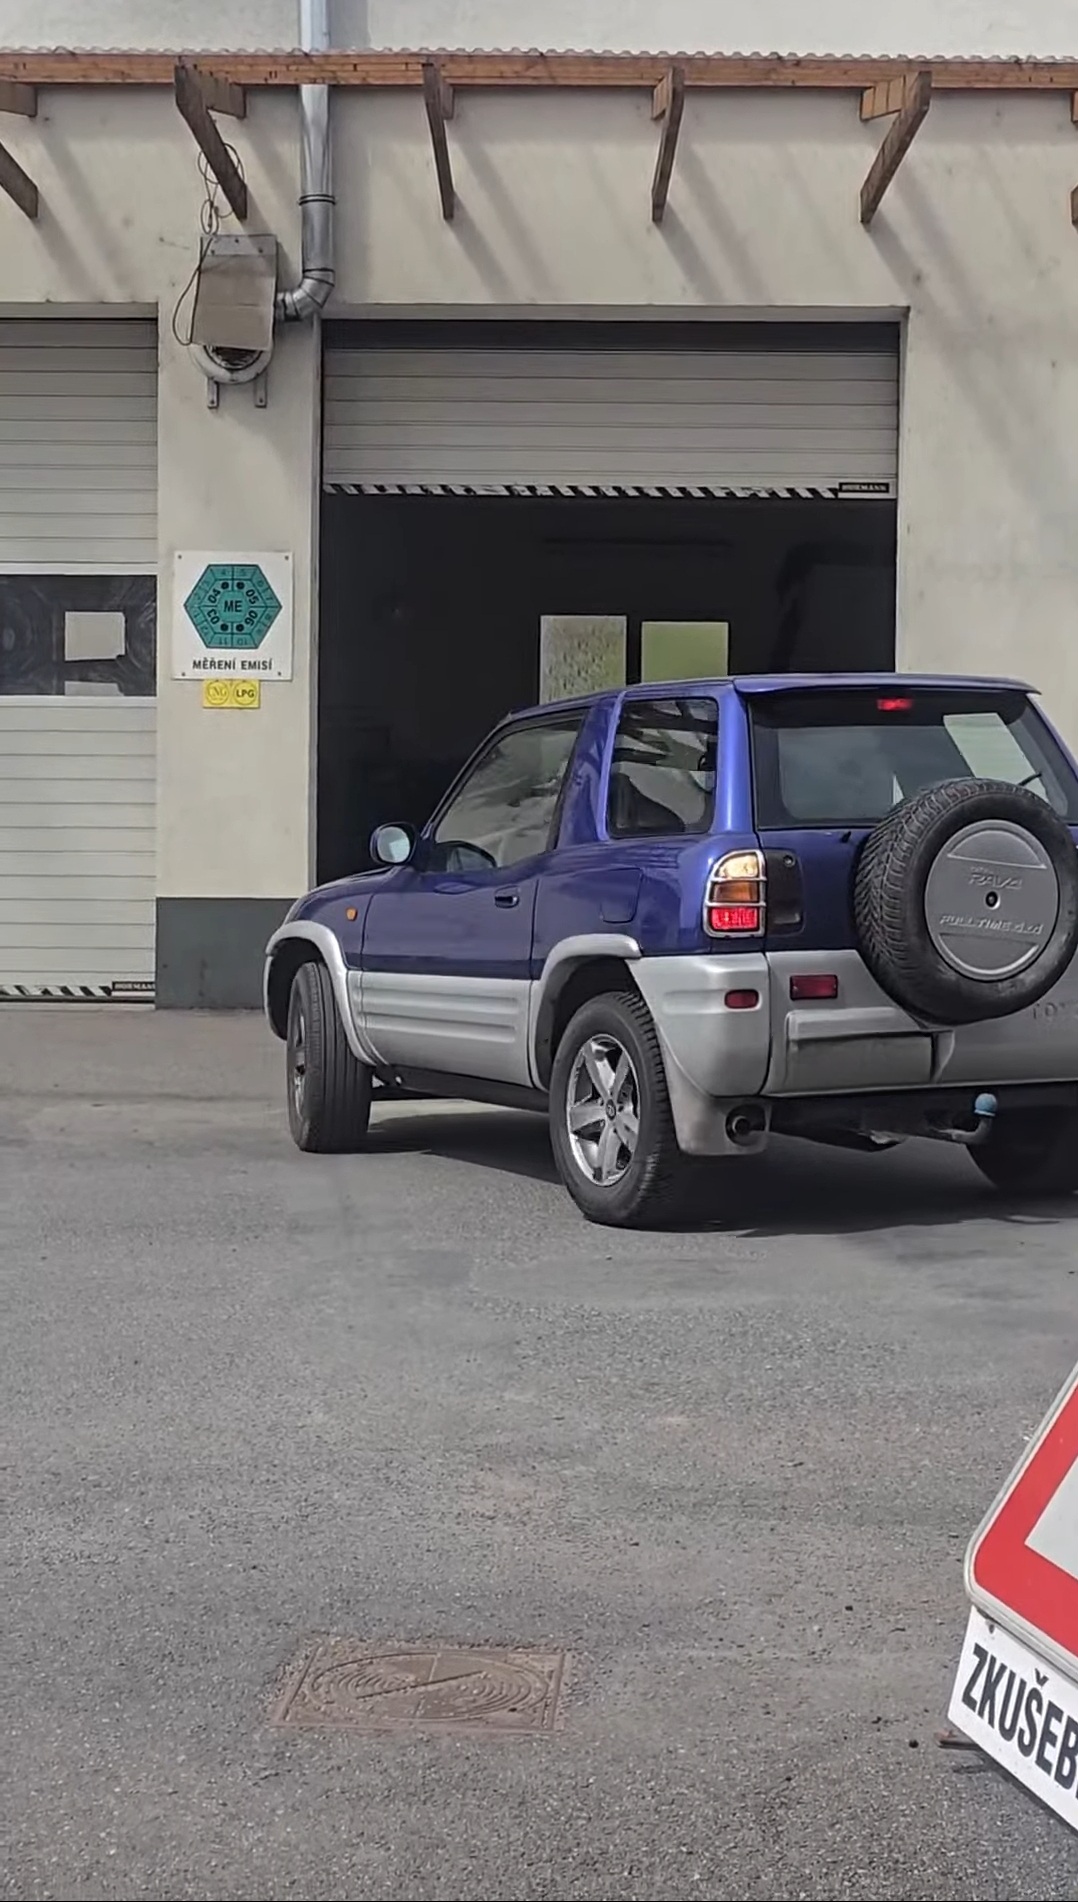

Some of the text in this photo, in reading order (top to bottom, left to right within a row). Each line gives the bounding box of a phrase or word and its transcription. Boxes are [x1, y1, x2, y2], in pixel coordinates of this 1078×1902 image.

[207, 588, 221, 604] 04
[245, 588, 260, 605] 05
[223, 600, 243, 613] ME
[206, 608, 220, 625] 03
[244, 610, 258, 627] 06
[192, 657, 272, 670] MĚŘENÍ EMISÍ
[236, 689, 255, 698] LPG
[962, 1642, 1078, 1800] ZKUŠEB
